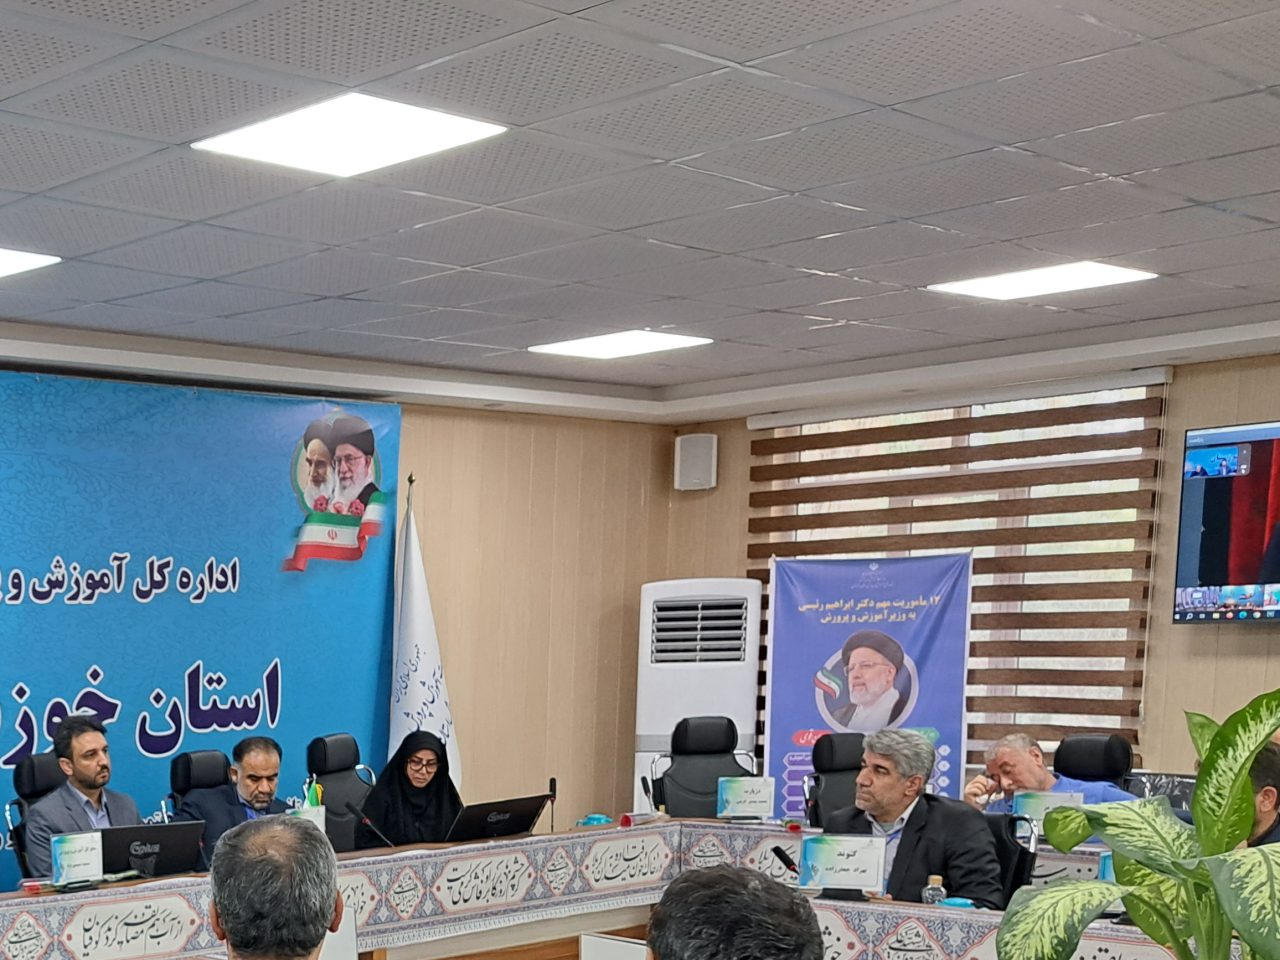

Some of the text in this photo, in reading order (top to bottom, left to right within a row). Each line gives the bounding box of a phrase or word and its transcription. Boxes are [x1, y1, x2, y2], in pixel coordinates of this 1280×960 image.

[6, 568, 23, 604] و
[30, 553, 129, 603] آموزش
[134, 557, 173, 602] کل
[178, 557, 239, 603] اداره
[820, 611, 850, 624] پرورش
[825, 598, 854, 611] ابراهیم
[857, 610, 888, 622] آموزش
[137, 658, 281, 758] استان
[130, 841, 161, 856] Gplus
